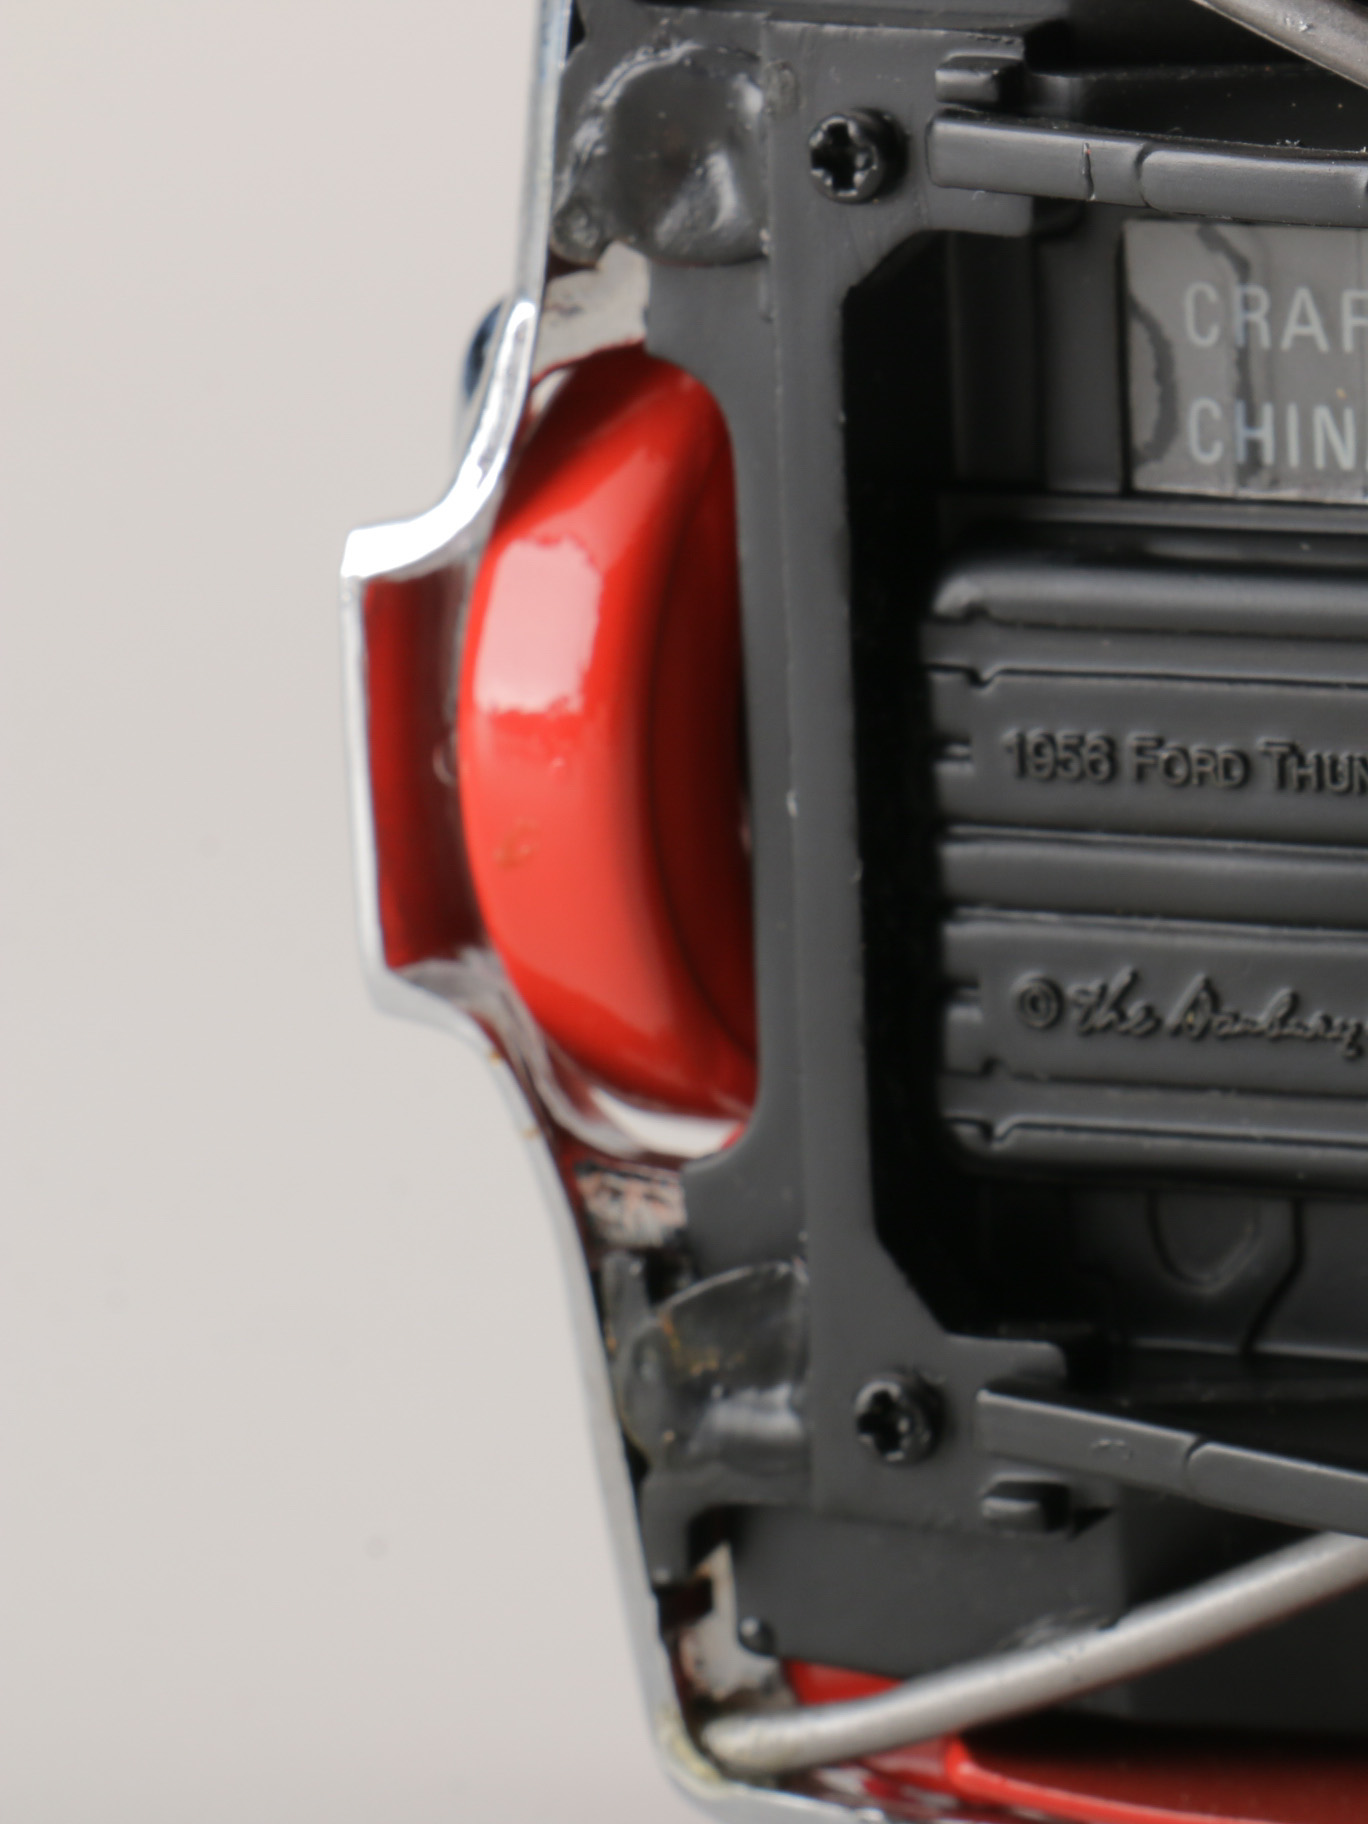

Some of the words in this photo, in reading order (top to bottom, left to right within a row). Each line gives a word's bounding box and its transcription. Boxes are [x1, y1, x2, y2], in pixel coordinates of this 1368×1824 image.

[1003, 729, 1117, 785] 1956
[1126, 735, 1250, 788] FORD
[1168, 973, 1366, 1061] Danbury
